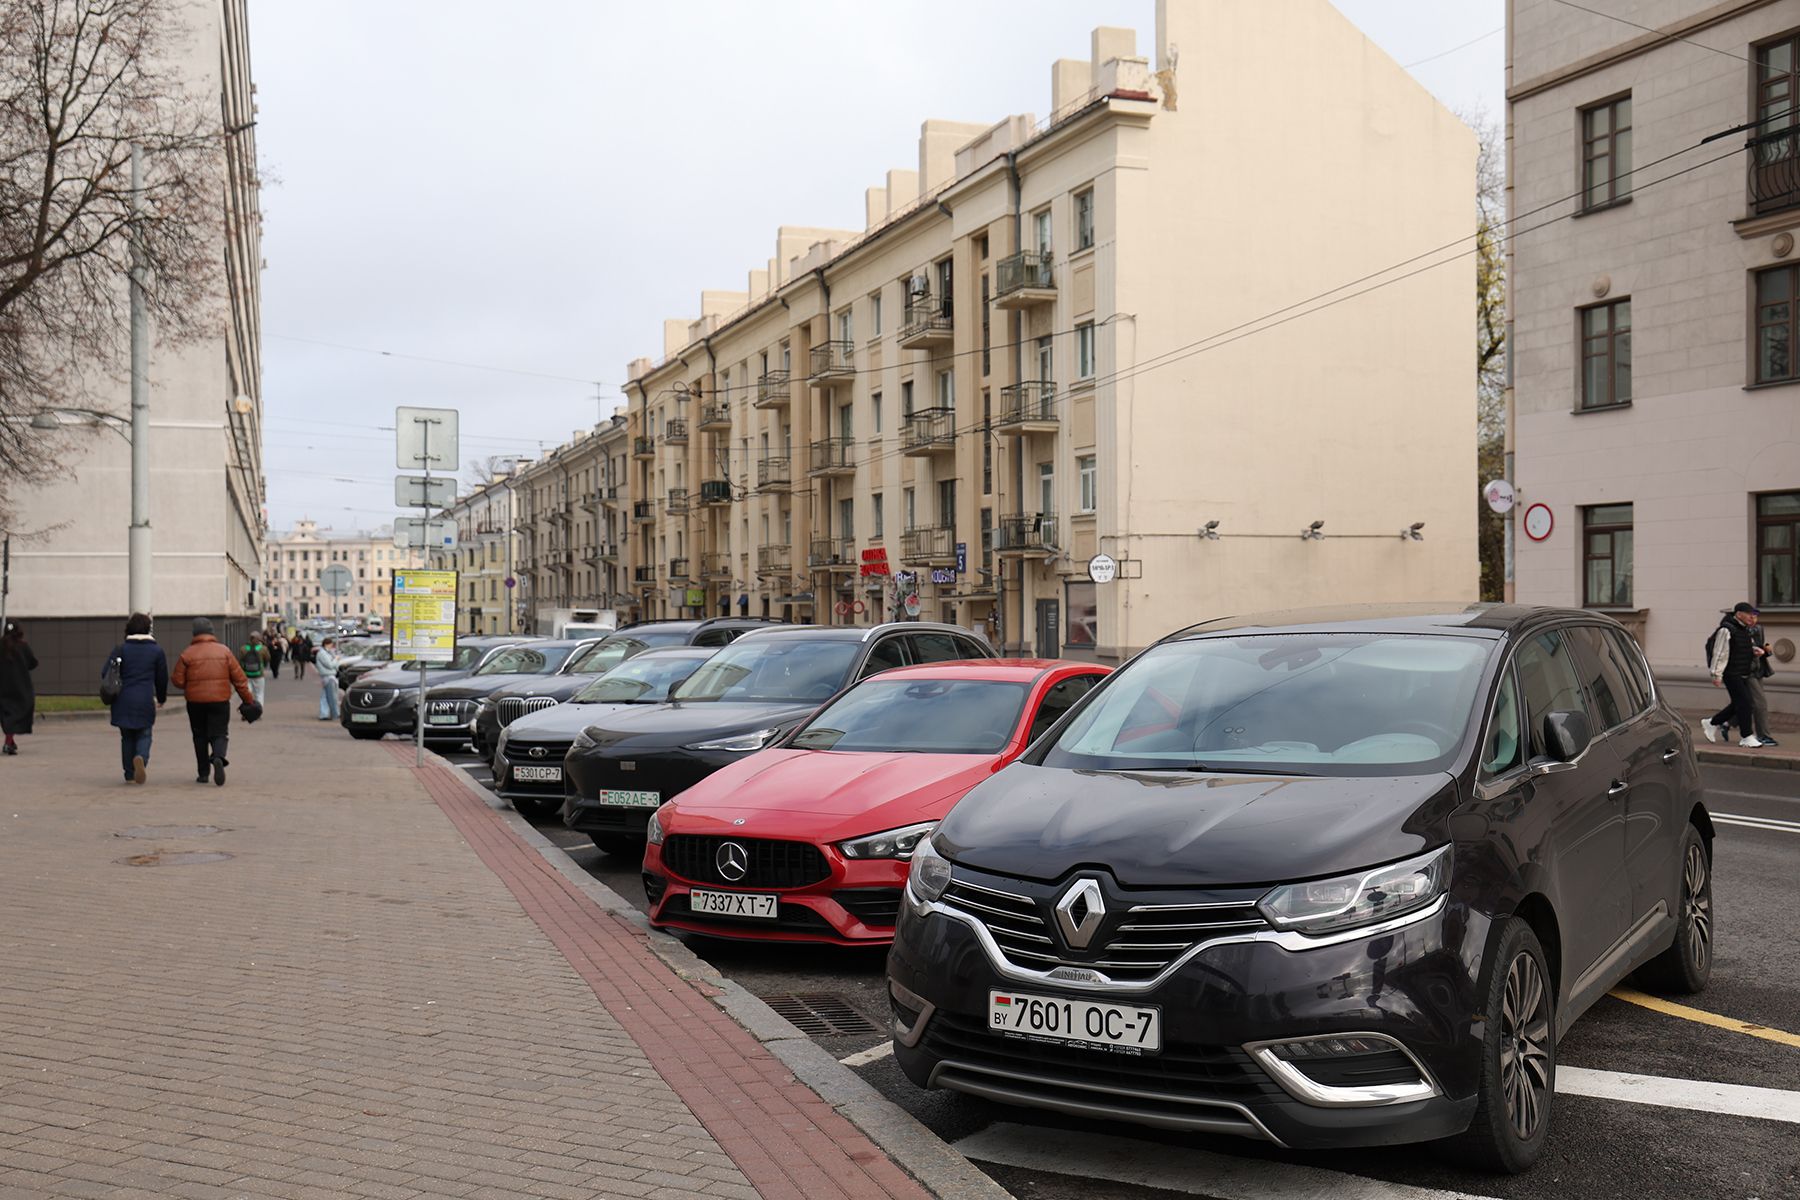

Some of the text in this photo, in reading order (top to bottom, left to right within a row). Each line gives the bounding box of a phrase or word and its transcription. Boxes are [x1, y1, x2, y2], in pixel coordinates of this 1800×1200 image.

[958, 555, 963, 571] 5
[520, 768, 560, 779] 5301 CP-7
[608, 792, 659, 806] E052 AE-3
[702, 893, 774, 915] 7337 XT-7
[994, 1012, 1008, 1025] BY
[1014, 997, 1153, 1043] 7601 OC-7
